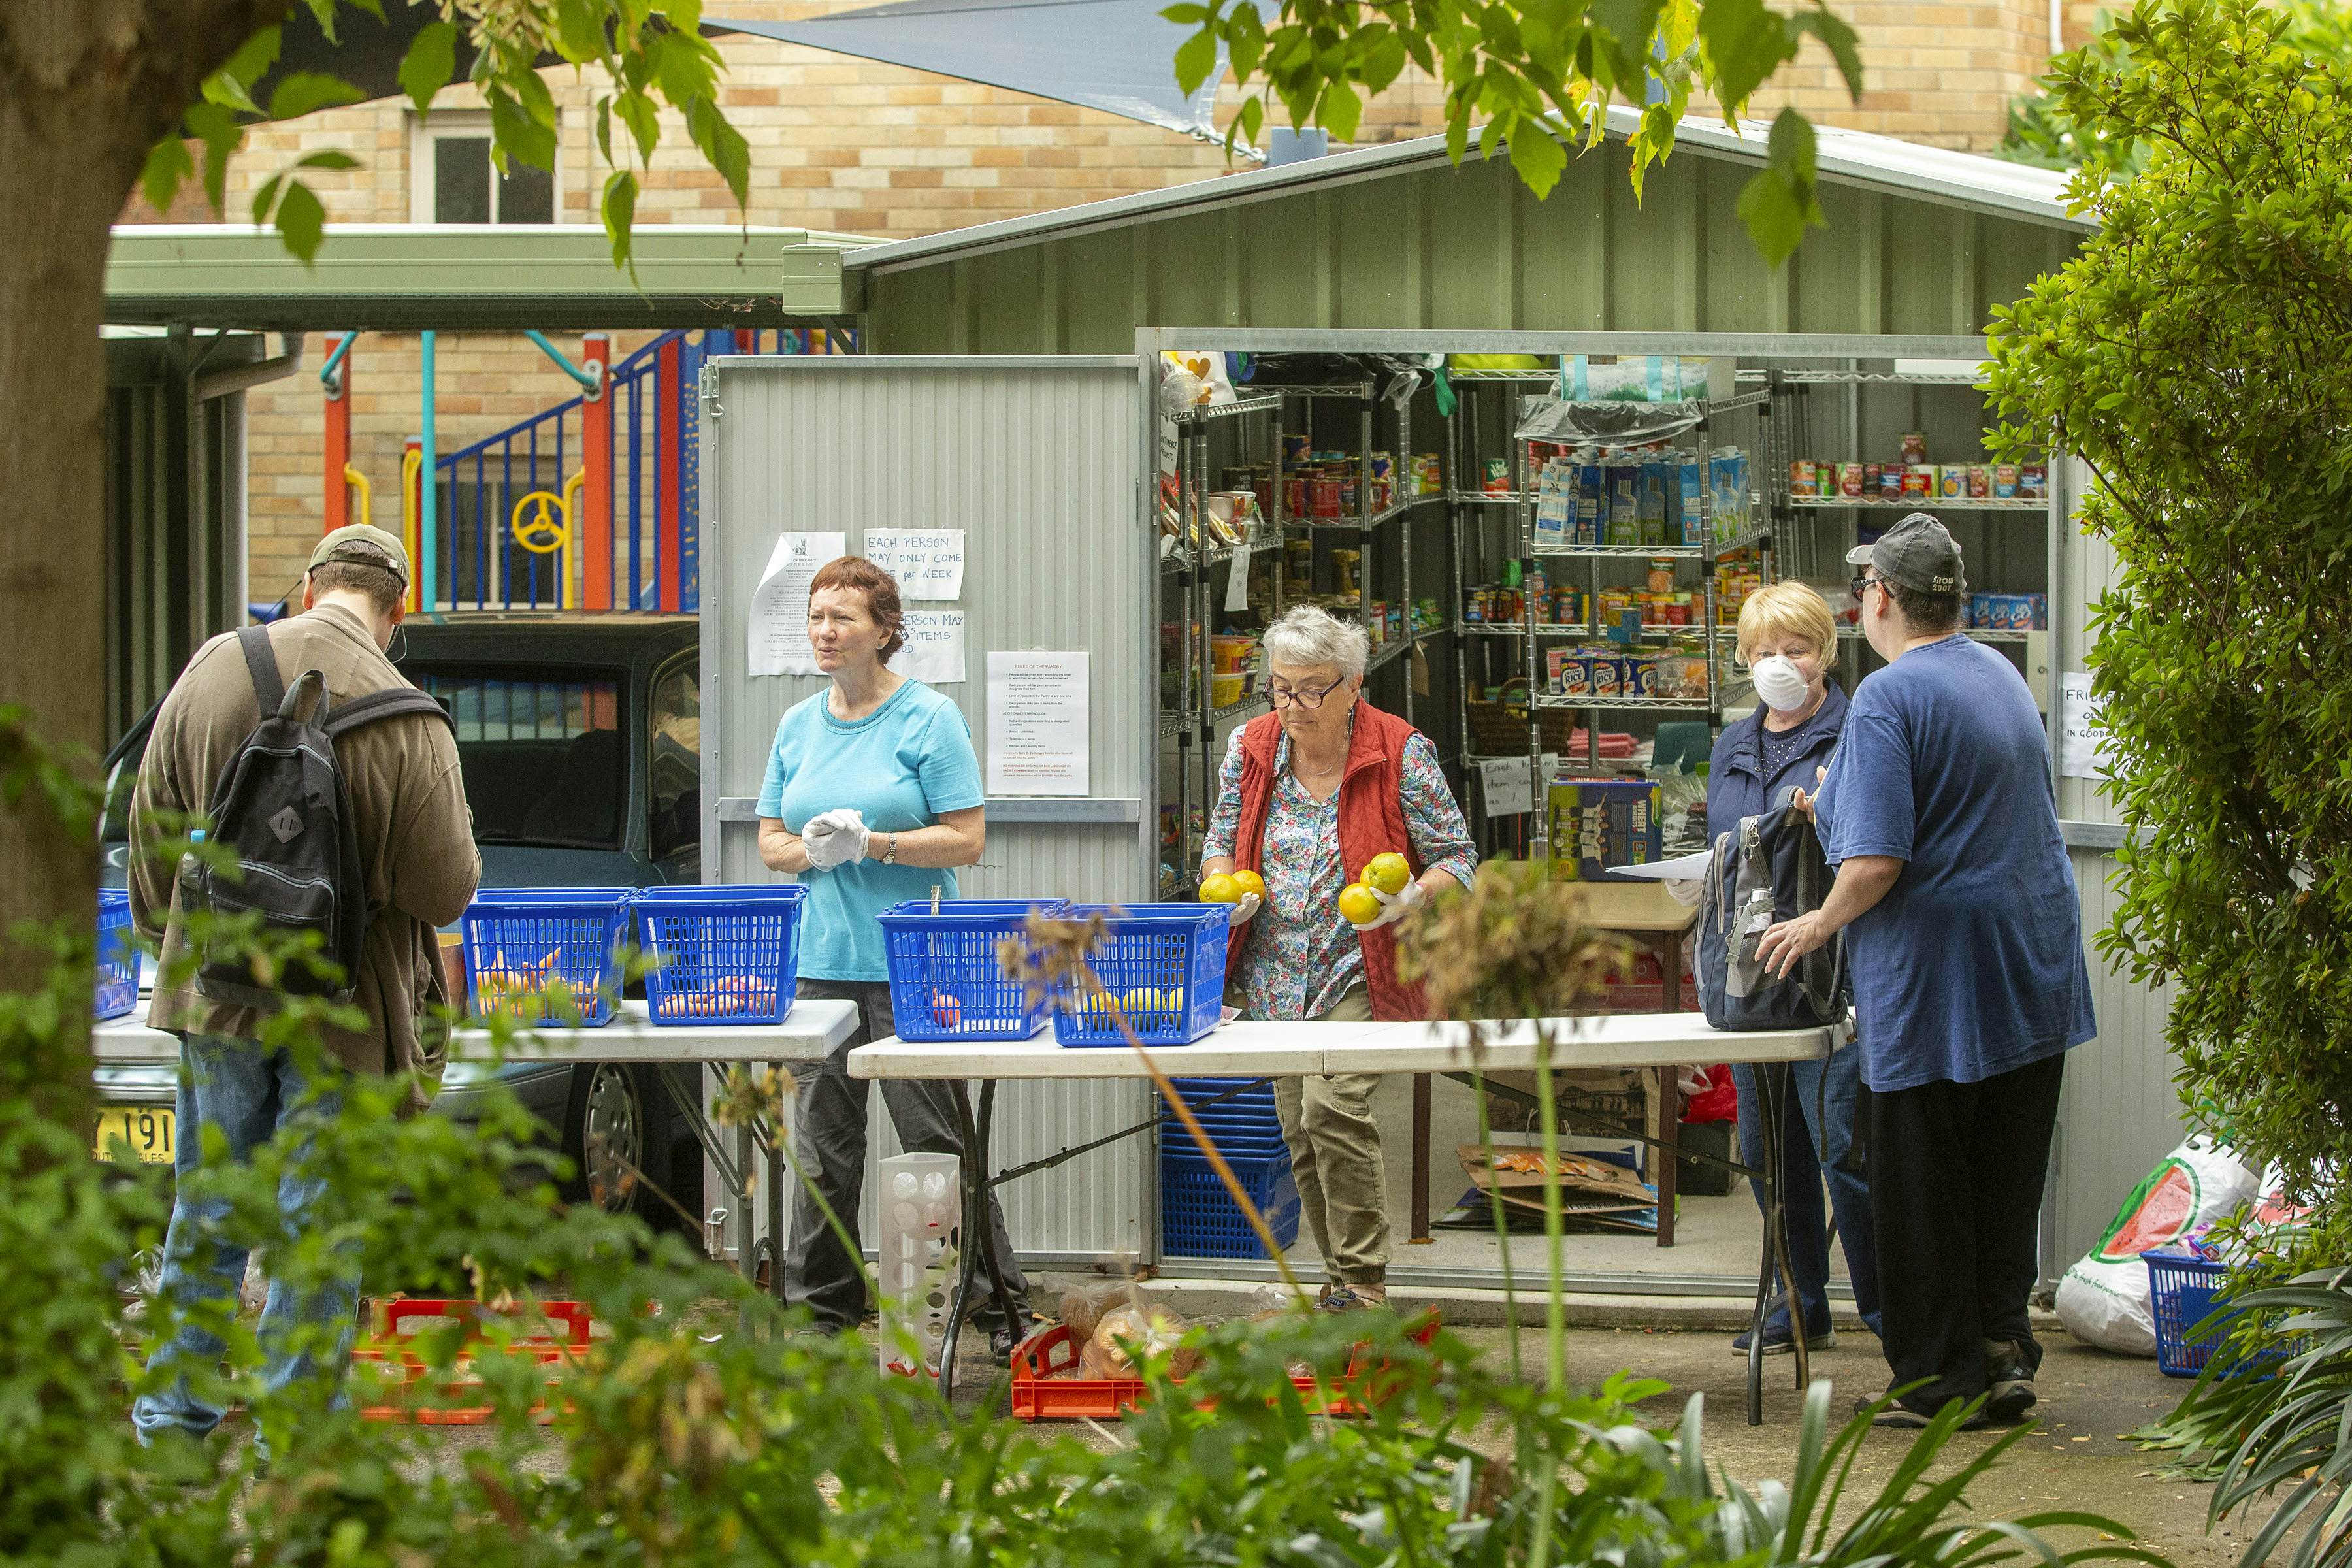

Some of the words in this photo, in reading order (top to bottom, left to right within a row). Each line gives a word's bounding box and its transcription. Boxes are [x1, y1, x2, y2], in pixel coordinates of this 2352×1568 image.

[868, 537, 898, 549] EACH
[904, 537, 949, 548] PERSON
[868, 552, 892, 565] MAY
[899, 553, 926, 563] ONLY
[934, 553, 962, 563] COME
[904, 572, 917, 582] per
[922, 569, 953, 578] WEEK
[904, 614, 937, 626] ERSON
[943, 614, 964, 626] MAY
[916, 632, 951, 640] ITEMS
[1565, 674, 1583, 684] RICE
[1596, 674, 1614, 684] RICE
[2080, 729, 2104, 738] GOOD
[1485, 762, 1512, 773] Each
[1487, 778, 1509, 789] item
[1637, 800, 1646, 833] WHEAT
[125, 1113, 169, 1151] 191
[138, 1152, 165, 1163] ALES
